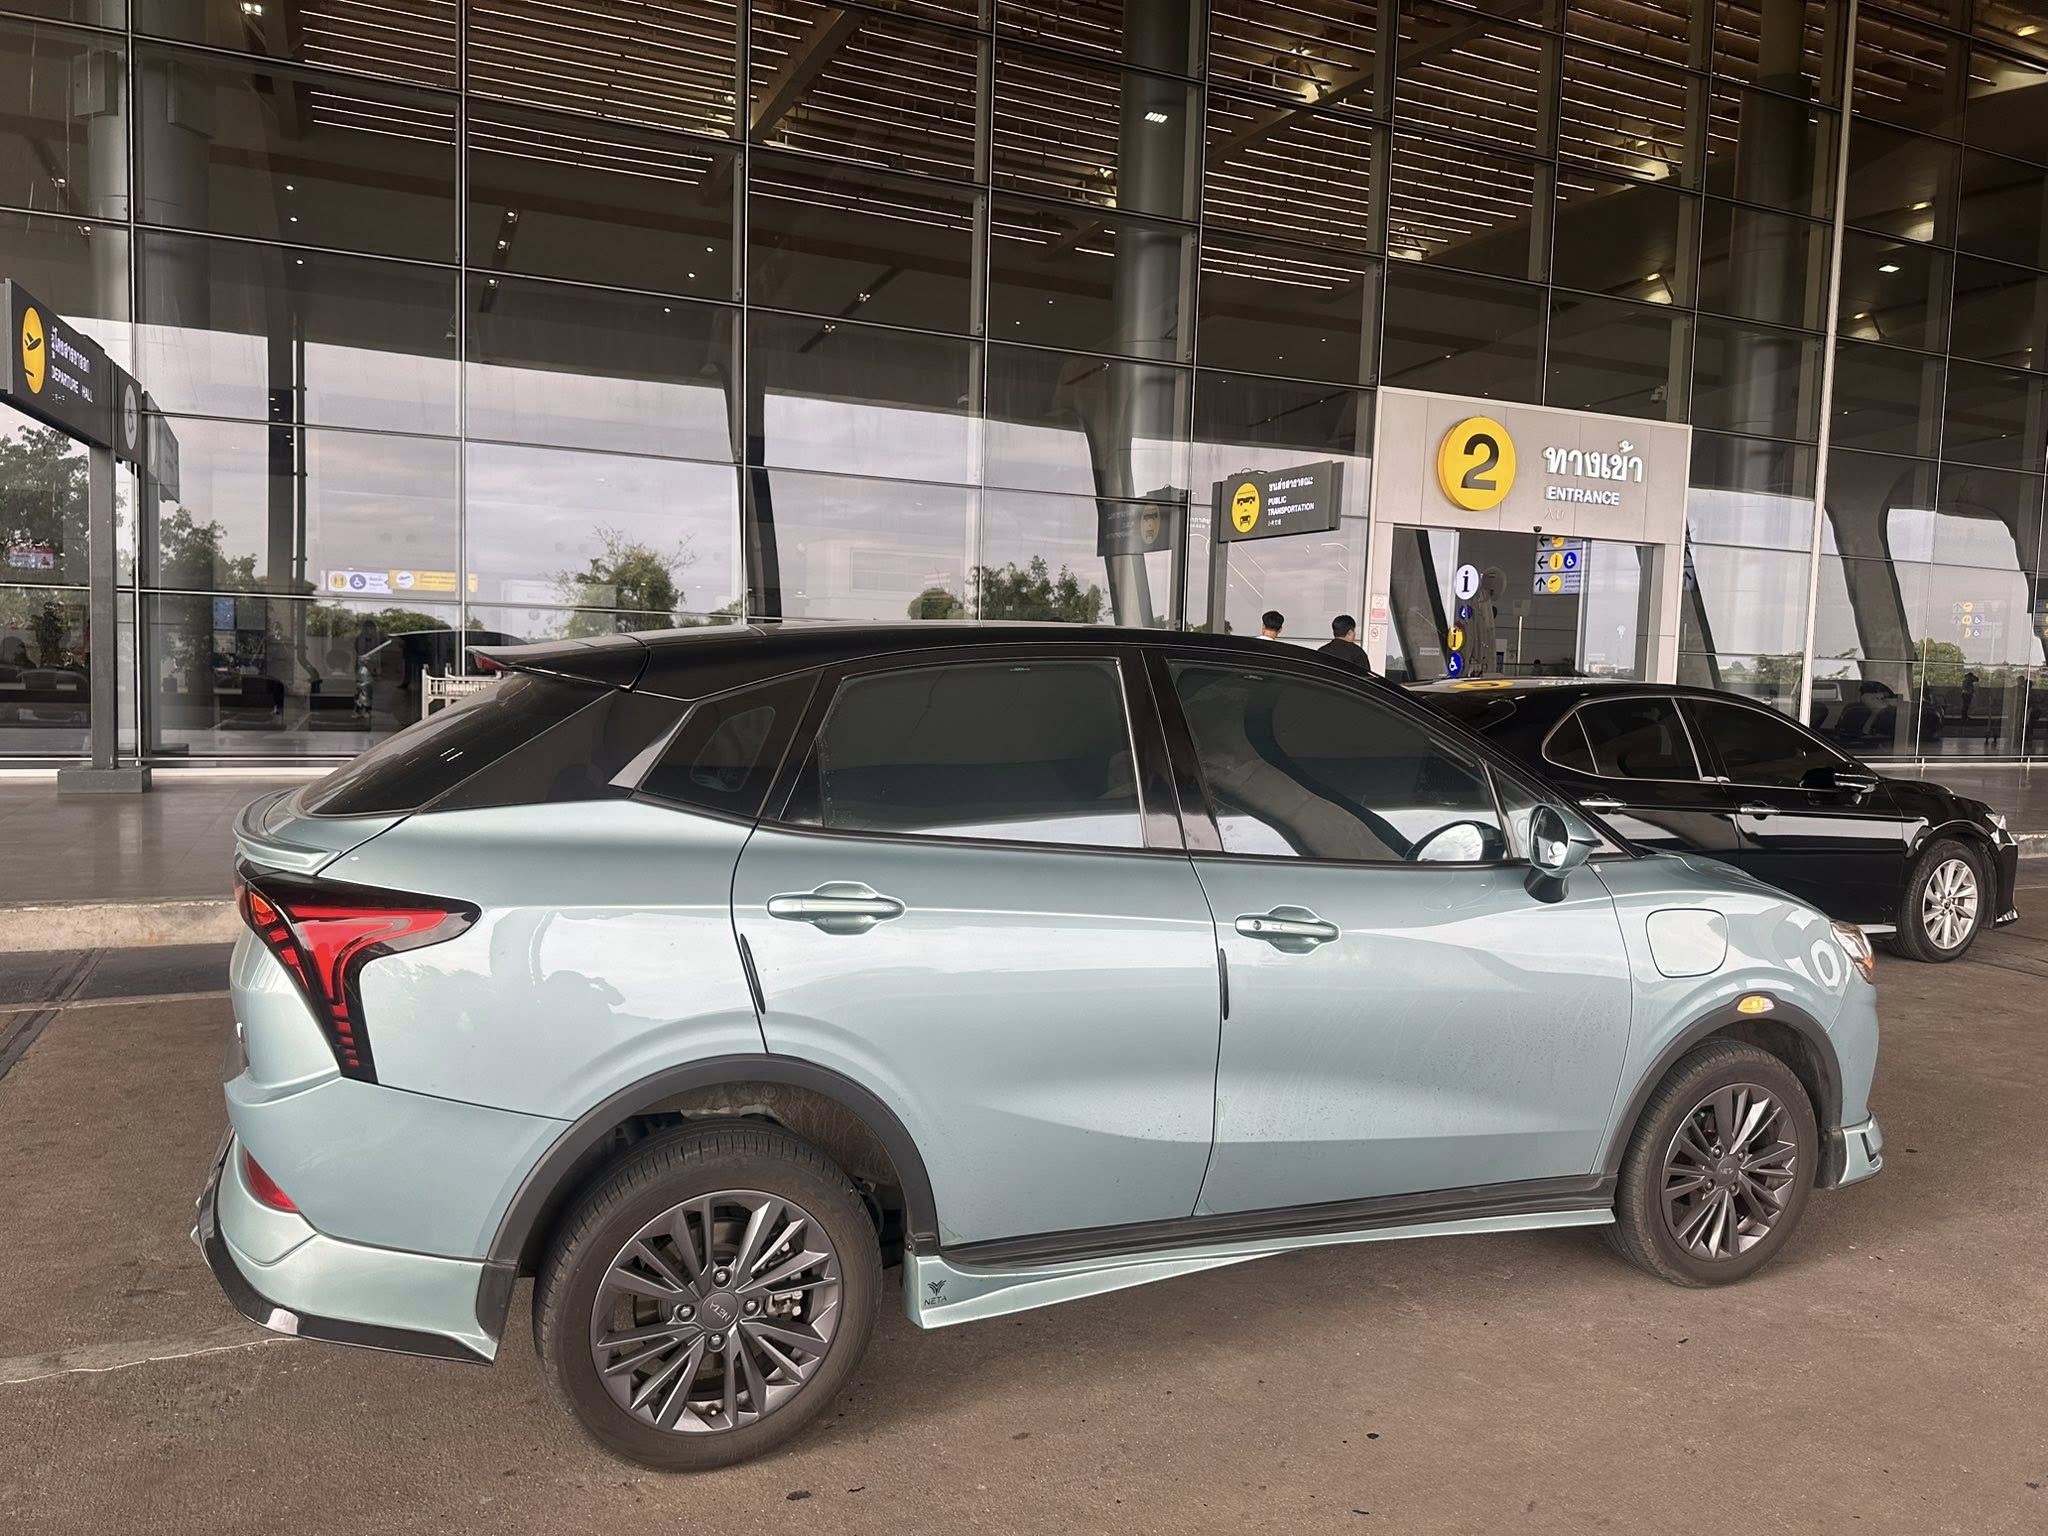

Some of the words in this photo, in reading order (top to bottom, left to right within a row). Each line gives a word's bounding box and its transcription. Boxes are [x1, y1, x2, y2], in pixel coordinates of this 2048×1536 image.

[82, 384, 94, 403] HALL
[1460, 433, 1500, 491] 2
[1545, 440, 1643, 483] ทางเข้า
[1268, 496, 1287, 505] PUBLIC
[1547, 486, 1620, 506] ENTRANCE
[1268, 502, 1315, 515] TRANSPORTATION
[924, 1296, 947, 1305] NETA
